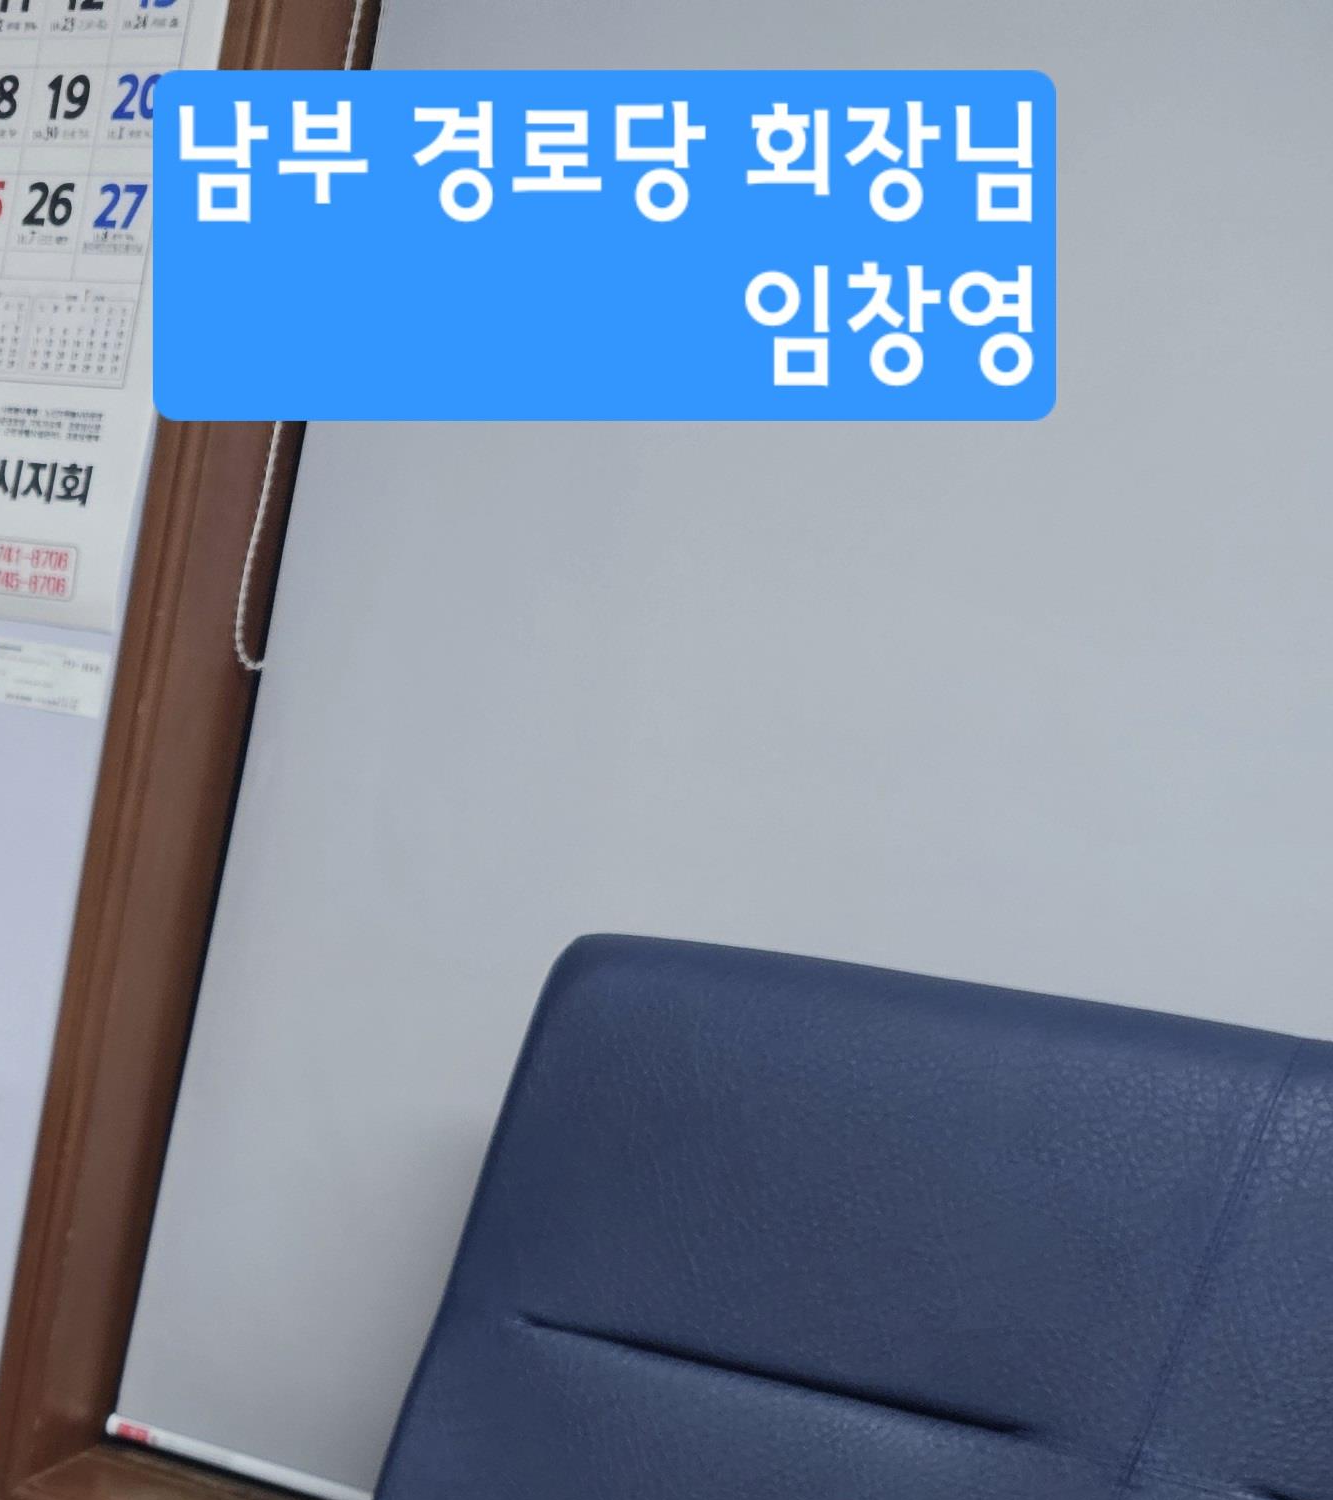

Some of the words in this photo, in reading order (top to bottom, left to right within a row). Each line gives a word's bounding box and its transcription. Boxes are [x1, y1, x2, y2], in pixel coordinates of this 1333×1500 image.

[47, 74, 91, 121] 19
[21, 181, 74, 226] 26
[92, 184, 148, 229] 27
